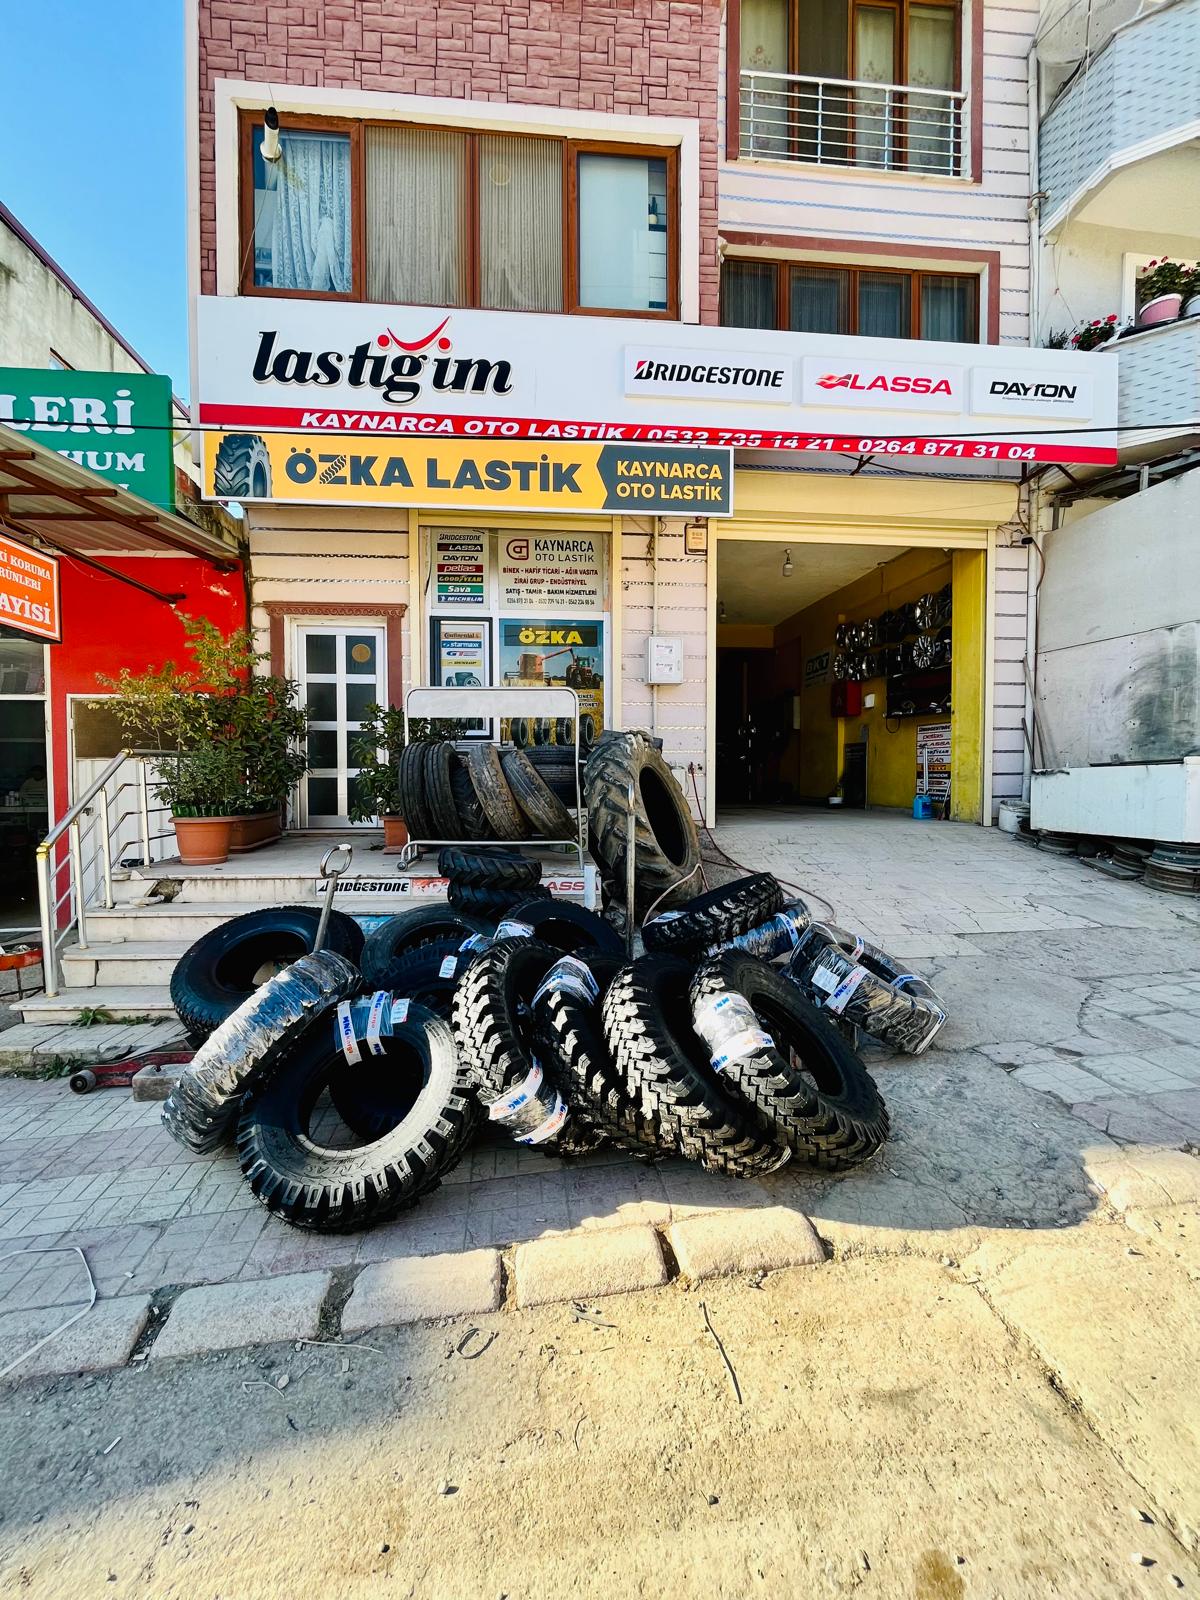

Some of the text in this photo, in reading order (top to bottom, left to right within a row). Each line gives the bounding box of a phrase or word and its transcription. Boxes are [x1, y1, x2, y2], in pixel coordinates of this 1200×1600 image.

[634, 360, 785, 388] BRIDGESTONE
[847, 374, 952, 396] LASSA
[989, 381, 1077, 399] DAYTON
[301, 411, 453, 434] KAYNARCA
[464, 418, 519, 436] OTO
[528, 419, 627, 439] LASTİK
[647, 429, 709, 444] 0532
[718, 432, 763, 447] 735
[772, 436, 799, 448] 14
[806, 437, 835, 450] 21
[857, 439, 916, 454] 0264
[924, 442, 965, 457] 871
[973, 445, 1000, 459] 31
[1008, 446, 1037, 460] 04
[285, 446, 583, 493] ÖZKA LASTİK
[616, 460, 723, 480] KAYNARCA
[616, 482, 723, 502] OTO LASTİK
[439, 533, 481, 541] BRIDGESTONE
[534, 539, 595, 553] KAYNARCA
[535, 552, 594, 562] OTO LASTİK
[10, 555, 51, 580] KORUMA
[444, 564, 476, 573] petlas
[524, 566, 541, 574] HAFİF
[542, 566, 561, 574] TİCARİ
[565, 566, 578, 575] AĞIR
[579, 568, 598, 576] VASITA
[448, 585, 471, 593] Sava
[550, 577, 587, 585] ENDÜSTRİYEL
[505, 588, 520, 596] SATIŞ
[518, 627, 584, 645] ÖZKA
[343, 1016, 351, 1035] MNG
